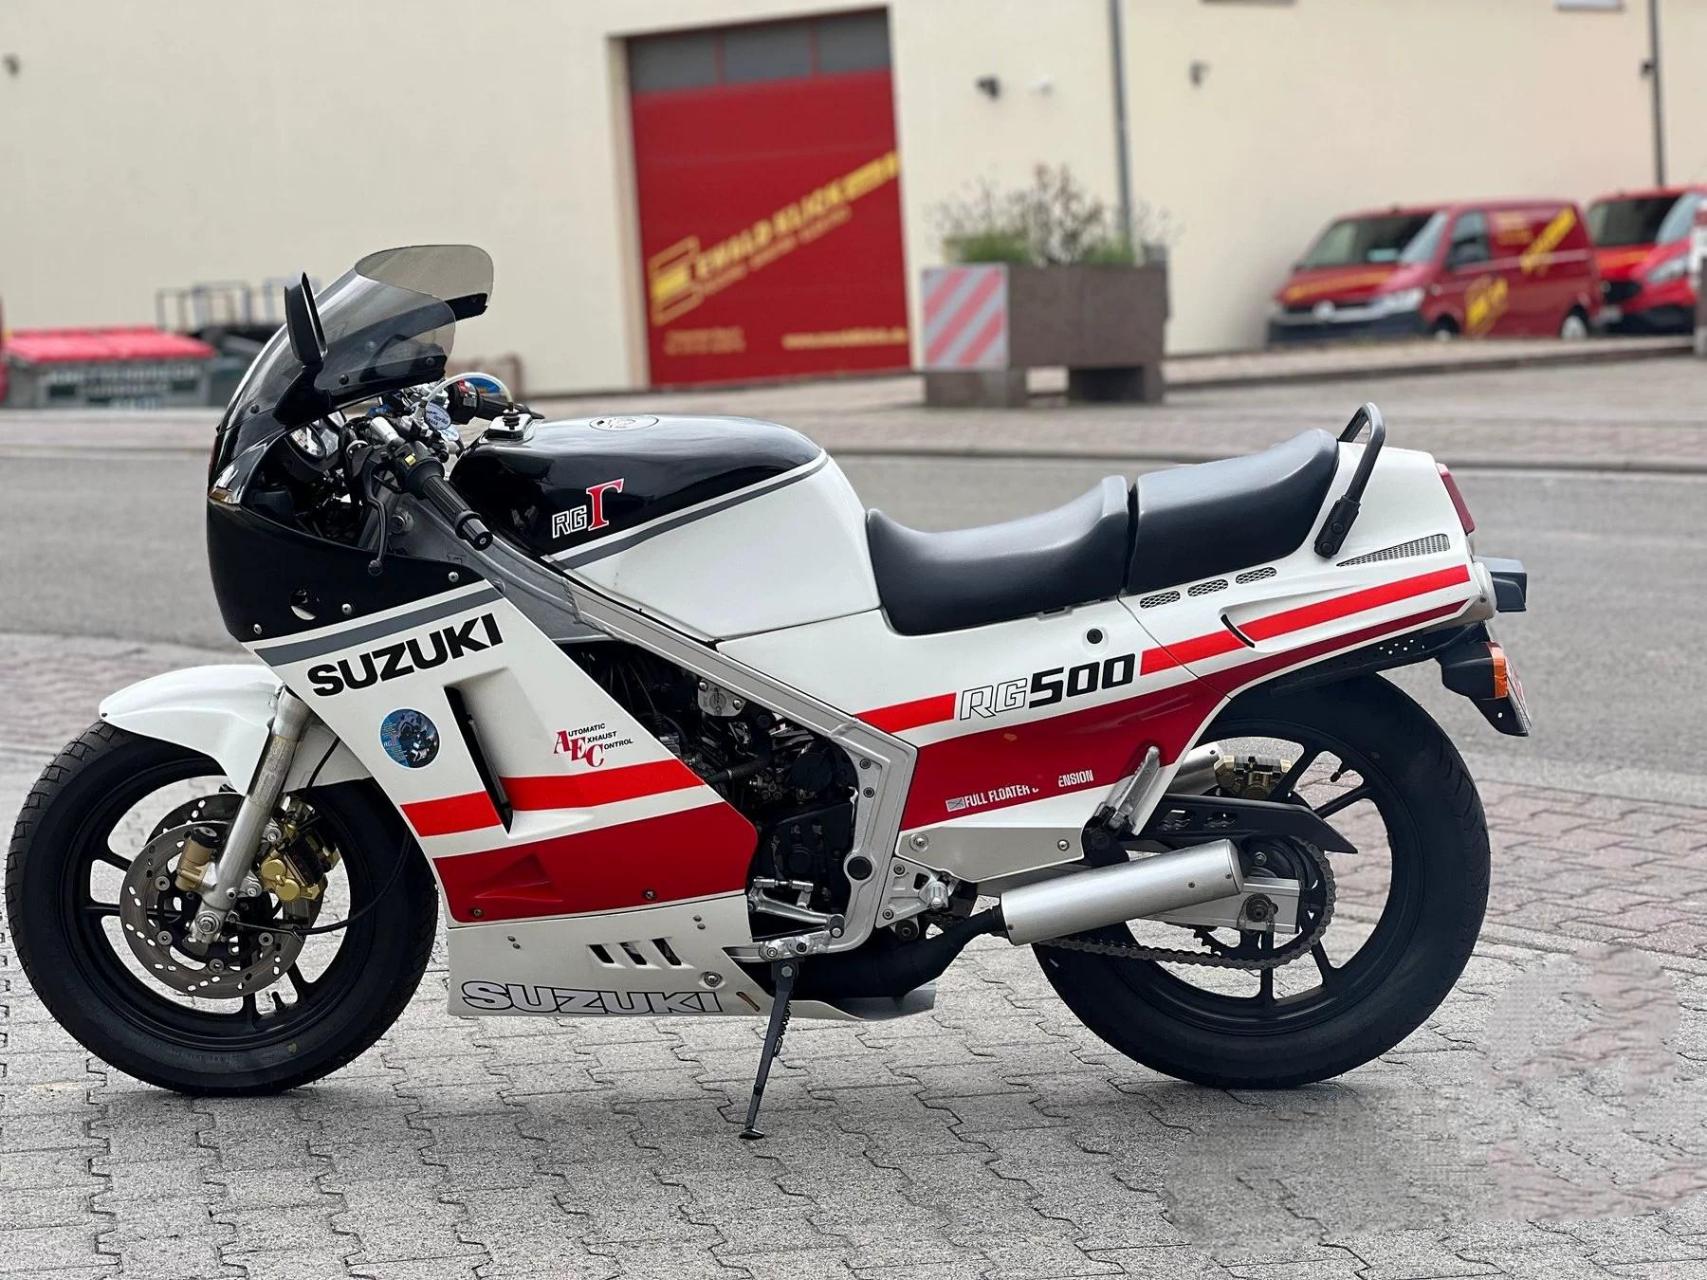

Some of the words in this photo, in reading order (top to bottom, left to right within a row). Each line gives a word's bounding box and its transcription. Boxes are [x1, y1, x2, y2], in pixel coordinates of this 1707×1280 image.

[307, 613, 503, 697] SUZUKI
[959, 653, 1136, 721] RG500
[964, 792, 988, 808] FULL
[461, 980, 723, 1015] SUZUKI
